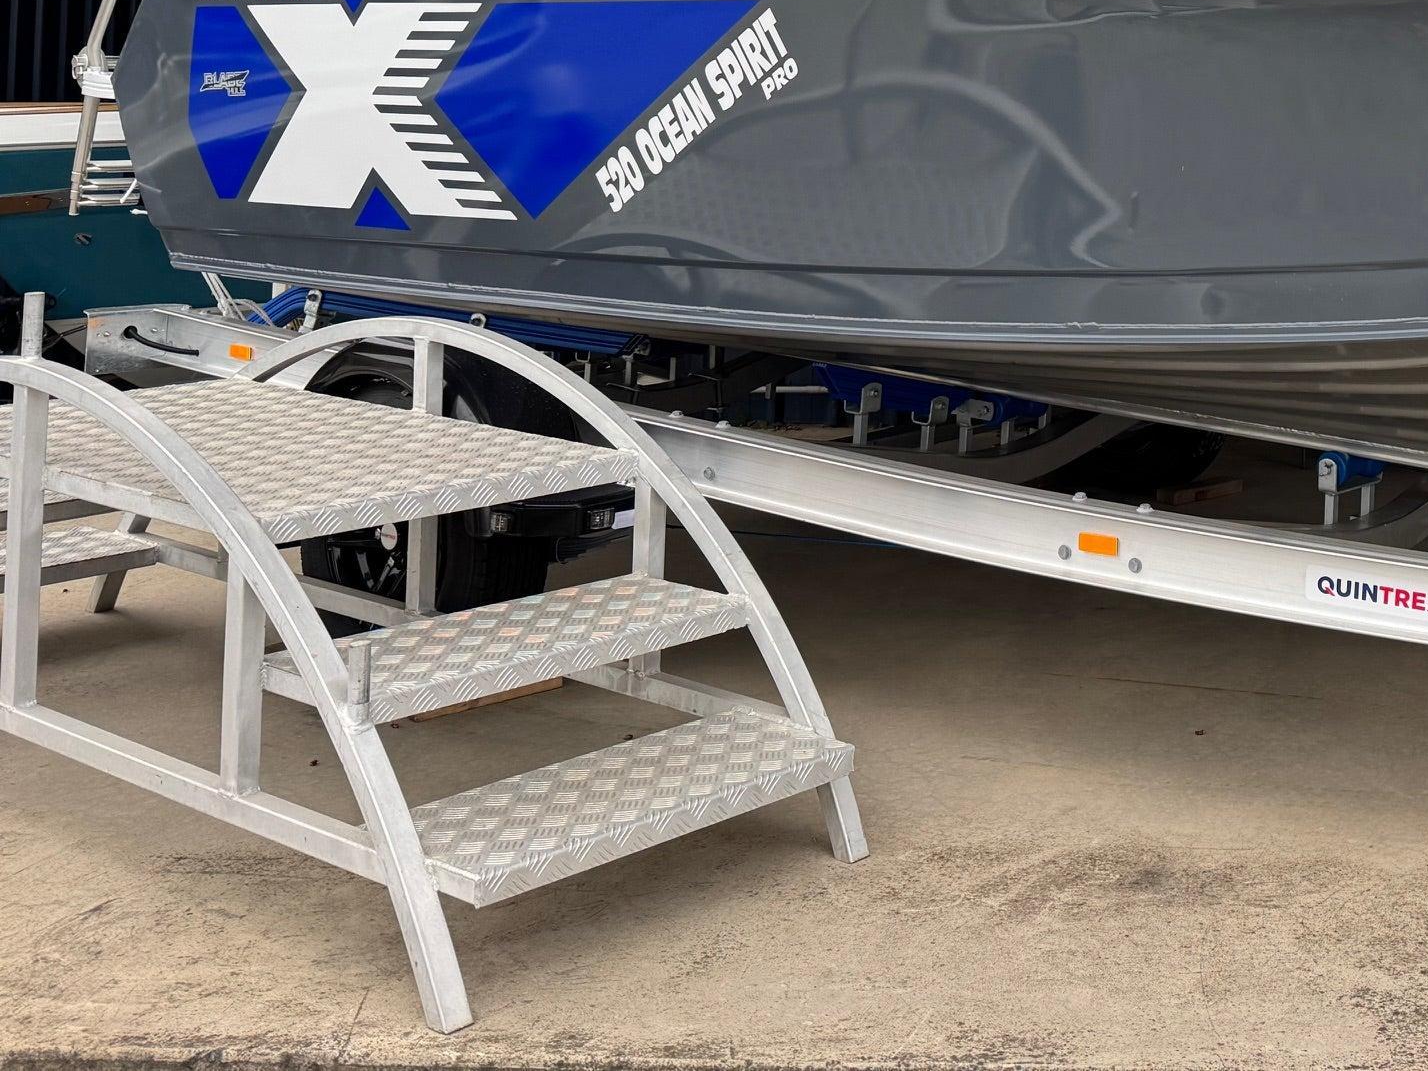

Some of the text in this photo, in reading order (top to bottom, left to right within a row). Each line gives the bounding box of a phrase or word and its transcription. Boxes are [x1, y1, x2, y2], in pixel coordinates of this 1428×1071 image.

[595, 7, 788, 213] 520 OCEAN SPIRIT
[761, 57, 799, 100] PRO
